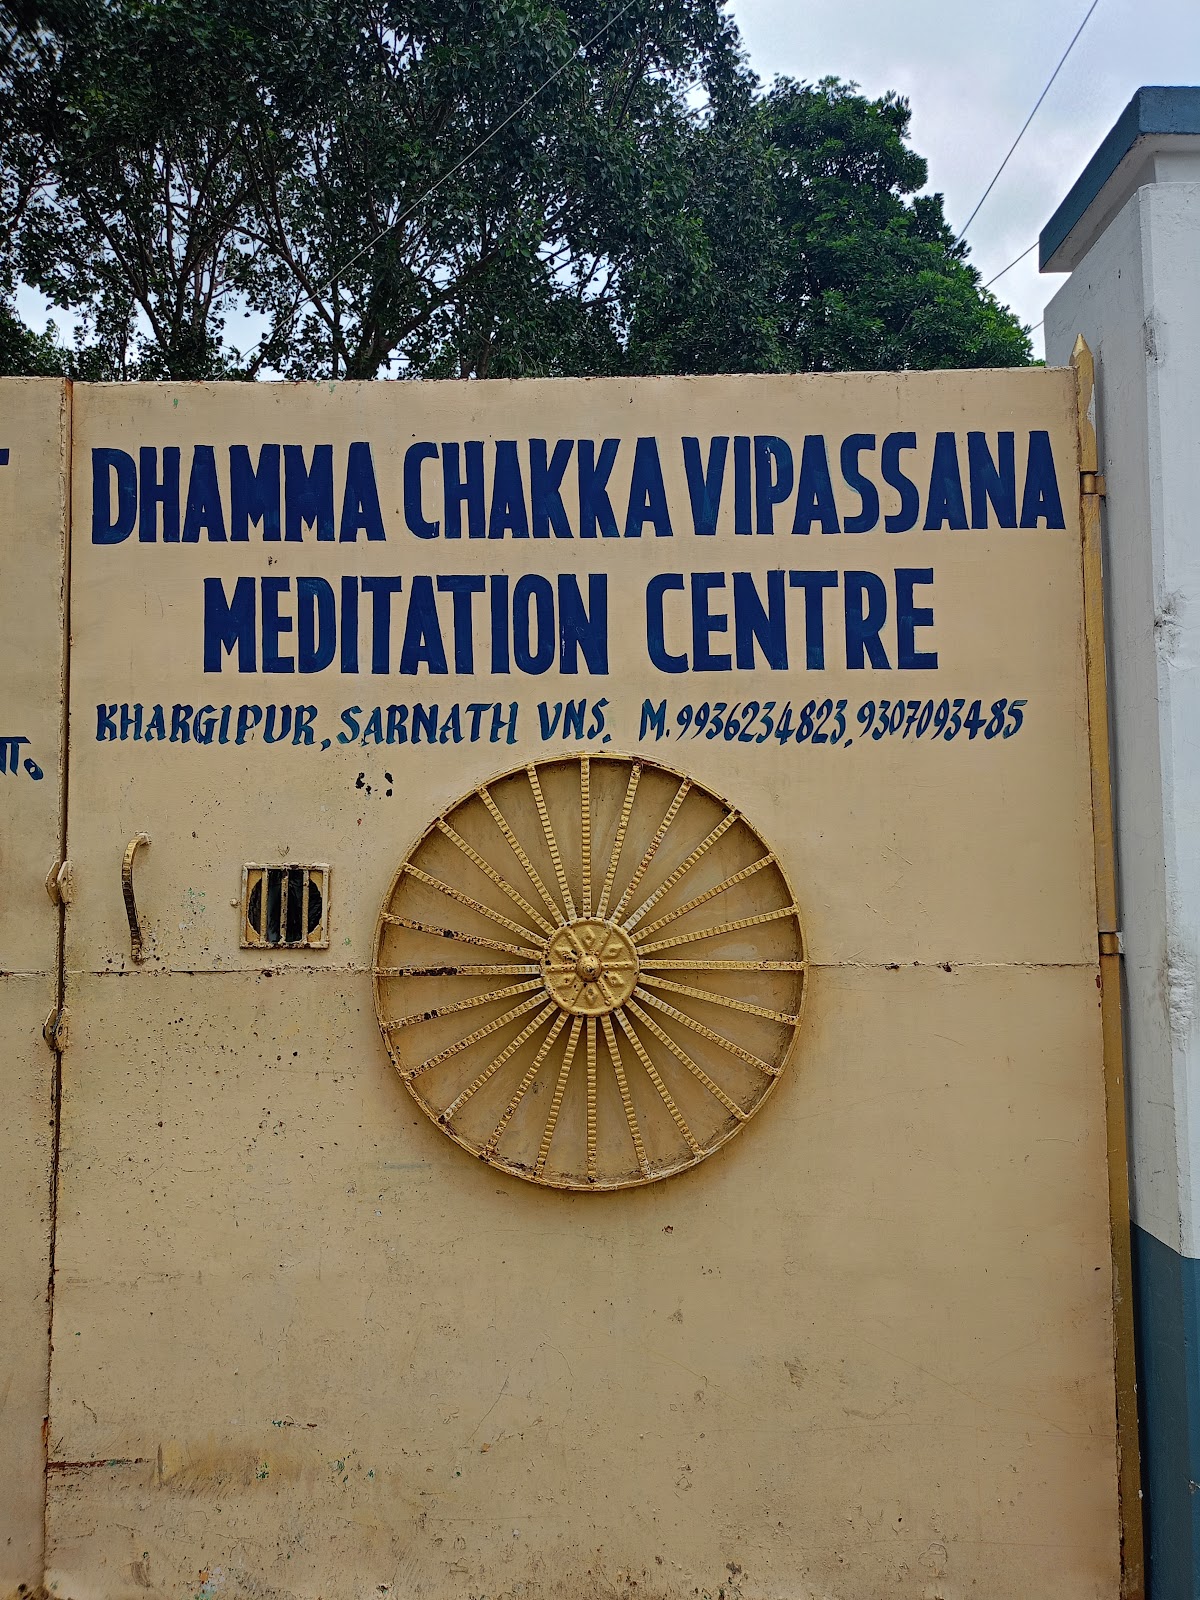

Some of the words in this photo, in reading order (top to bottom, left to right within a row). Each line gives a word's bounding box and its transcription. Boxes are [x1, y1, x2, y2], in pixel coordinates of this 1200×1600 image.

[91, 441, 387, 546] DHAMMA
[403, 436, 674, 540] CHAKKA
[681, 430, 1066, 536] VIPASSANA
[203, 573, 609, 676] MEDITATION
[645, 567, 939, 674] CENTRE
[95, 702, 332, 752] KHARGIPUR,
[336, 701, 519, 747] SARNATH
[537, 697, 612, 744] VNS.
